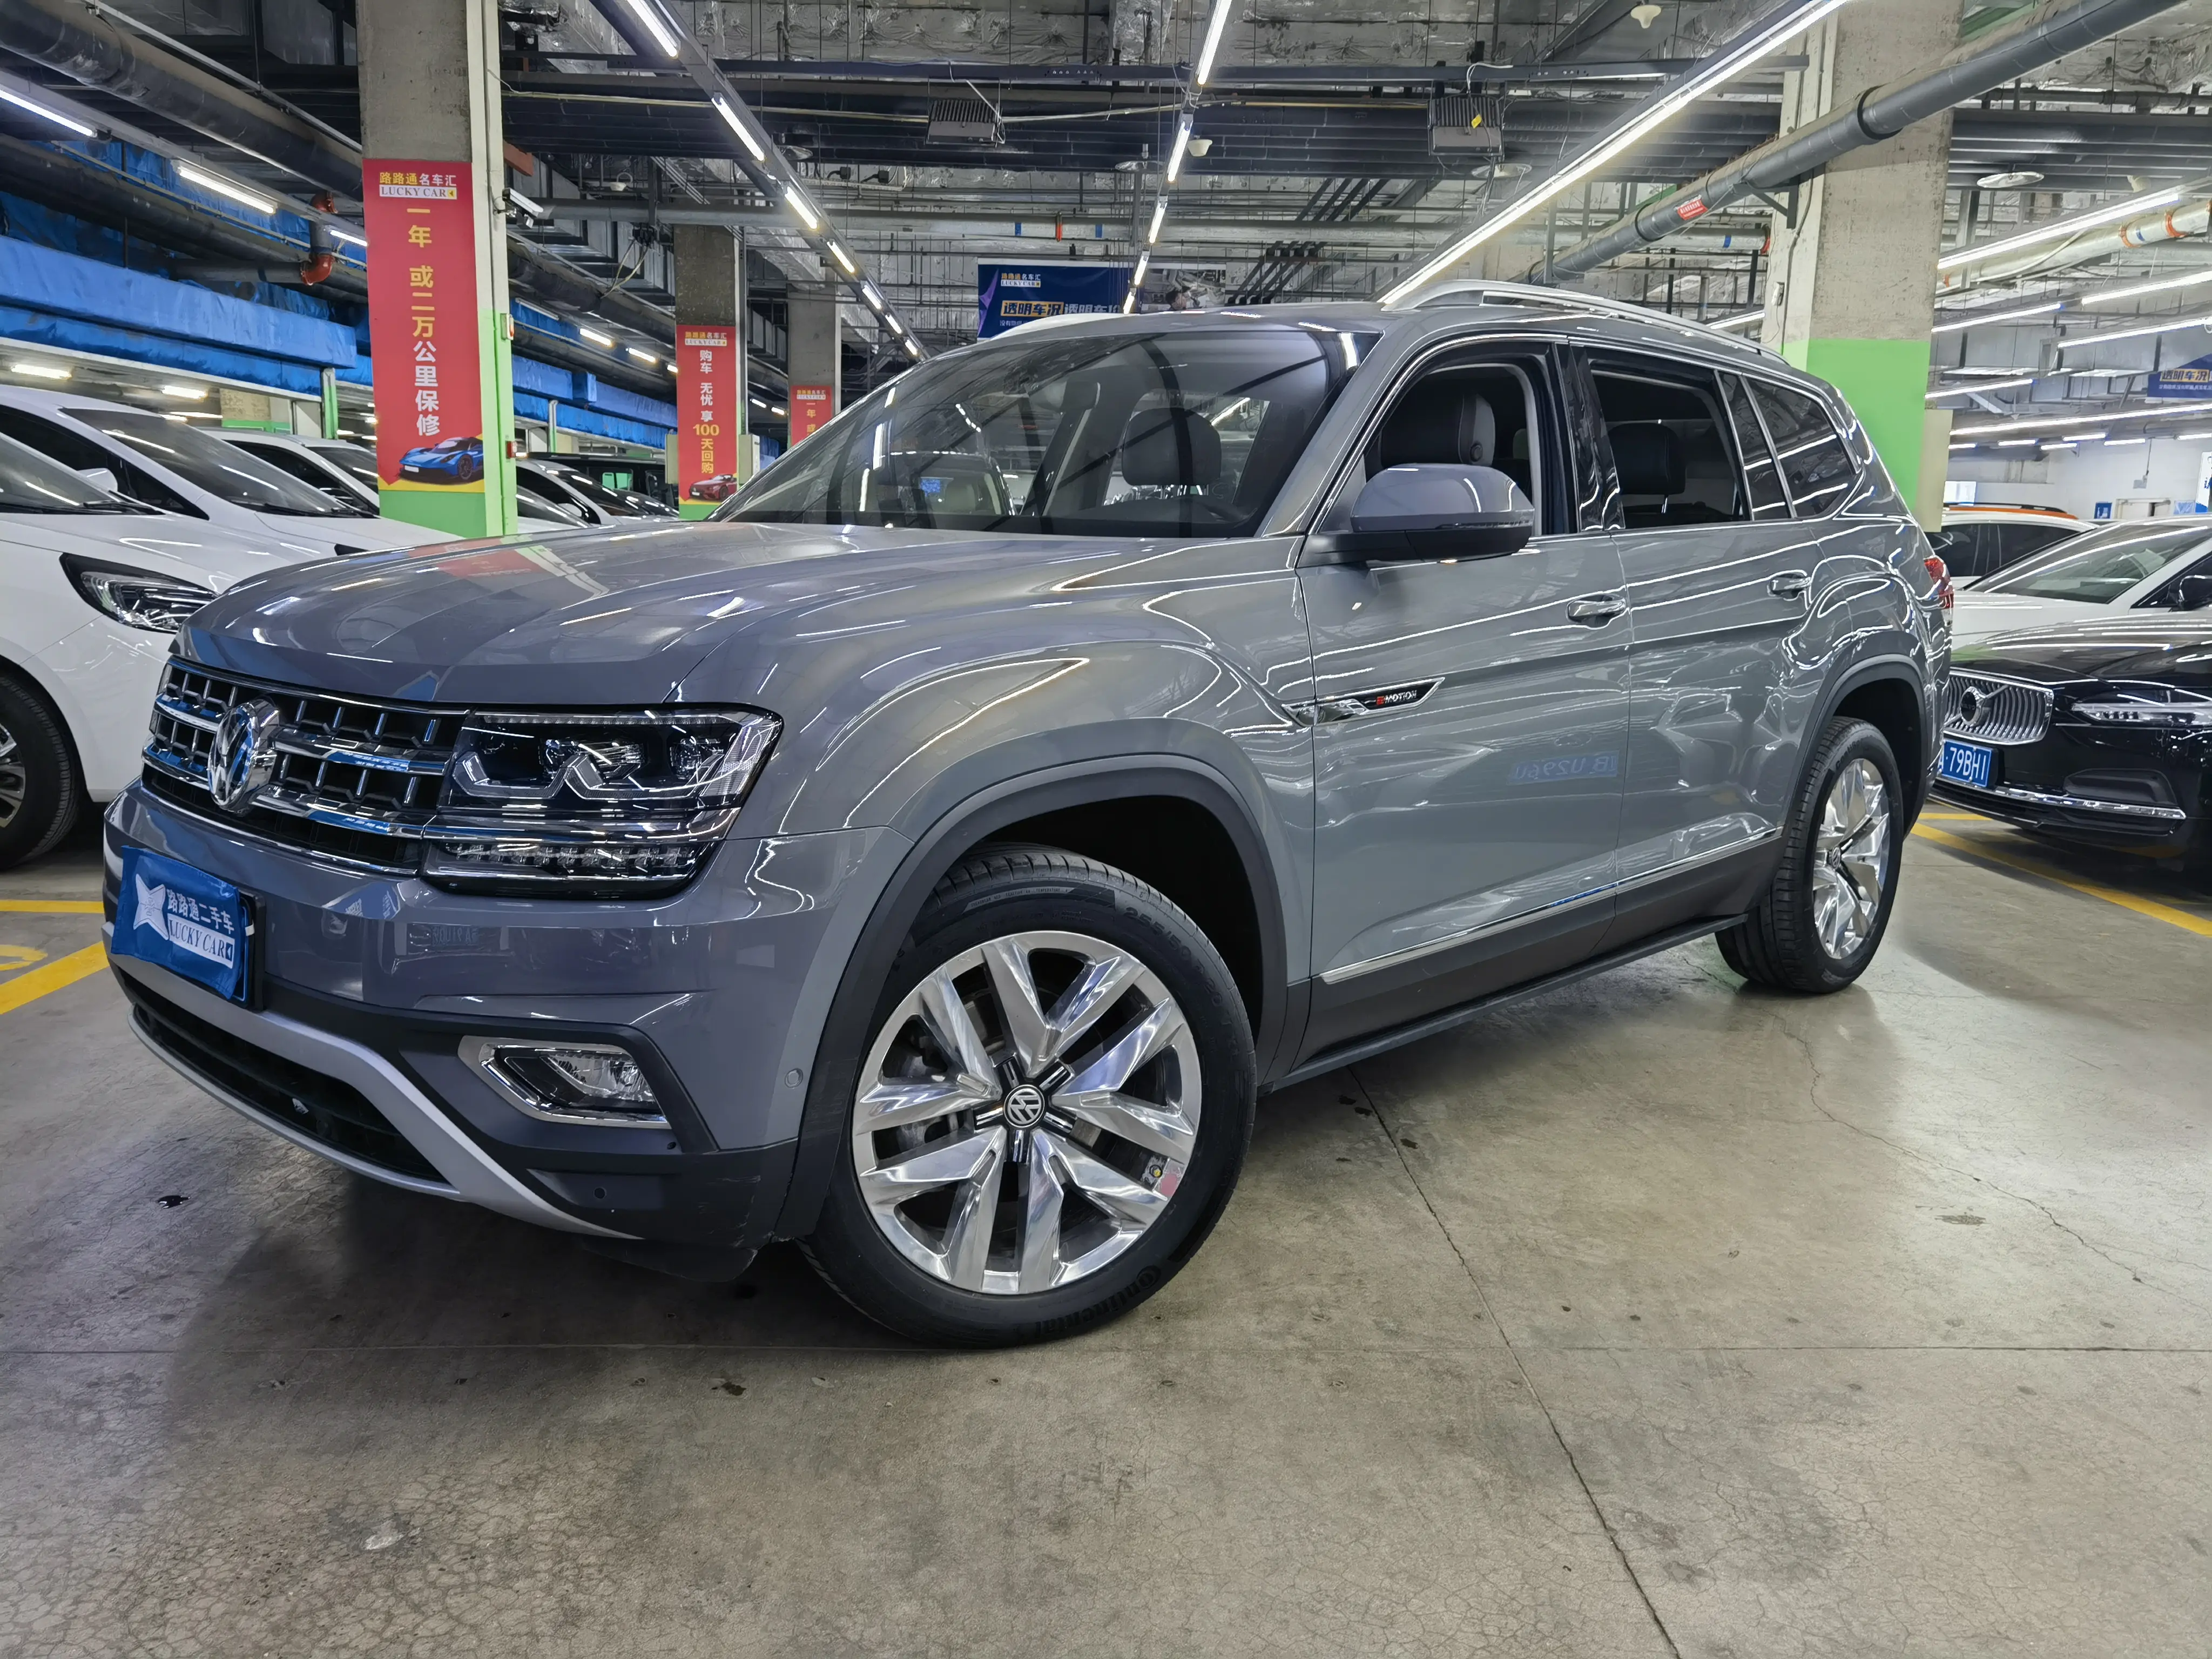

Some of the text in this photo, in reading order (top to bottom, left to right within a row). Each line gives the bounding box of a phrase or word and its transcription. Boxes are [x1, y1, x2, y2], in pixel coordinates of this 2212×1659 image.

[379, 172, 457, 186] 路路通名车汇
[381, 186, 447, 197] LUCKY CAR
[1003, 302, 1062, 315] 透明车况
[167, 889, 235, 935] 路路通二手车
[169, 919, 225, 959] LUCKY CAR
